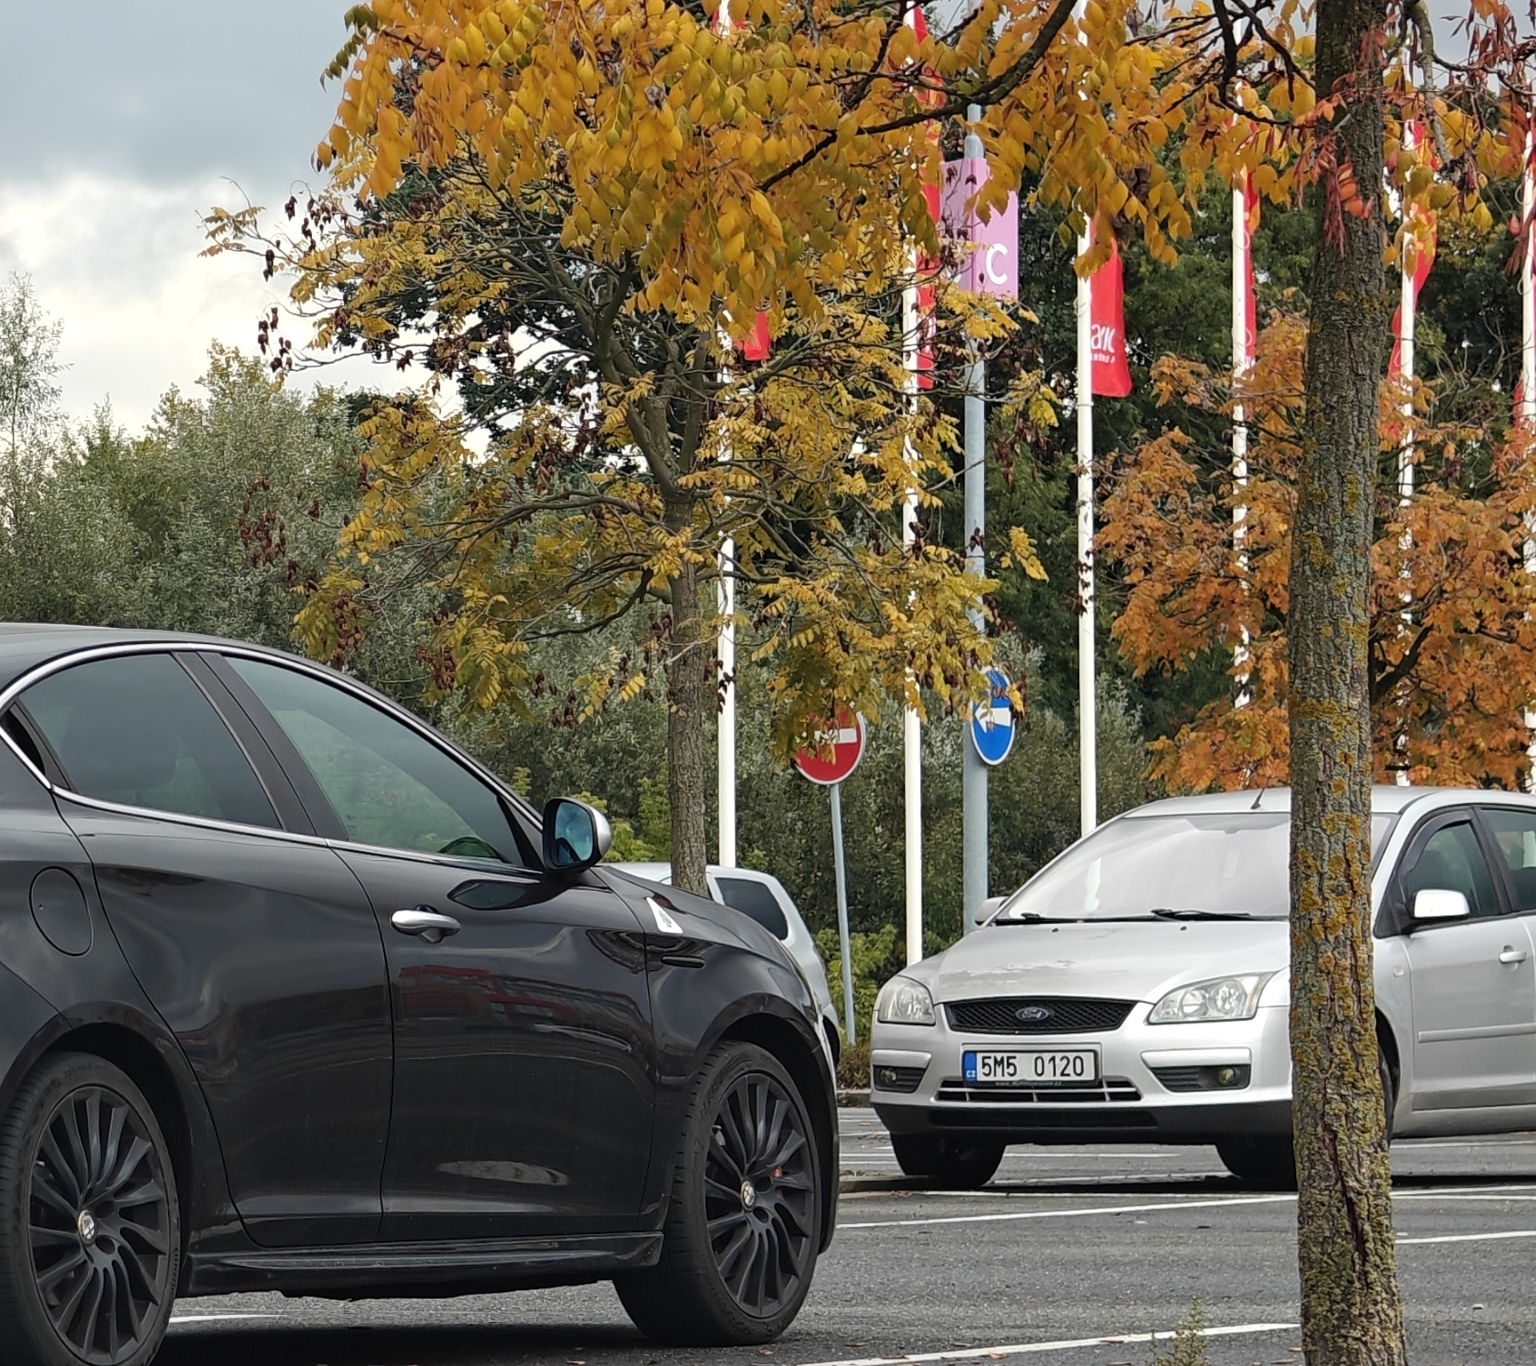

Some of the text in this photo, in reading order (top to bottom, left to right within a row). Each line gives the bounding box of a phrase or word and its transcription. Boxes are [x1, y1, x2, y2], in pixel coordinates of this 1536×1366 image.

[985, 242, 1009, 285] C
[966, 1070, 976, 1078] CZ
[981, 1055, 1085, 1077] 5M5 0120
